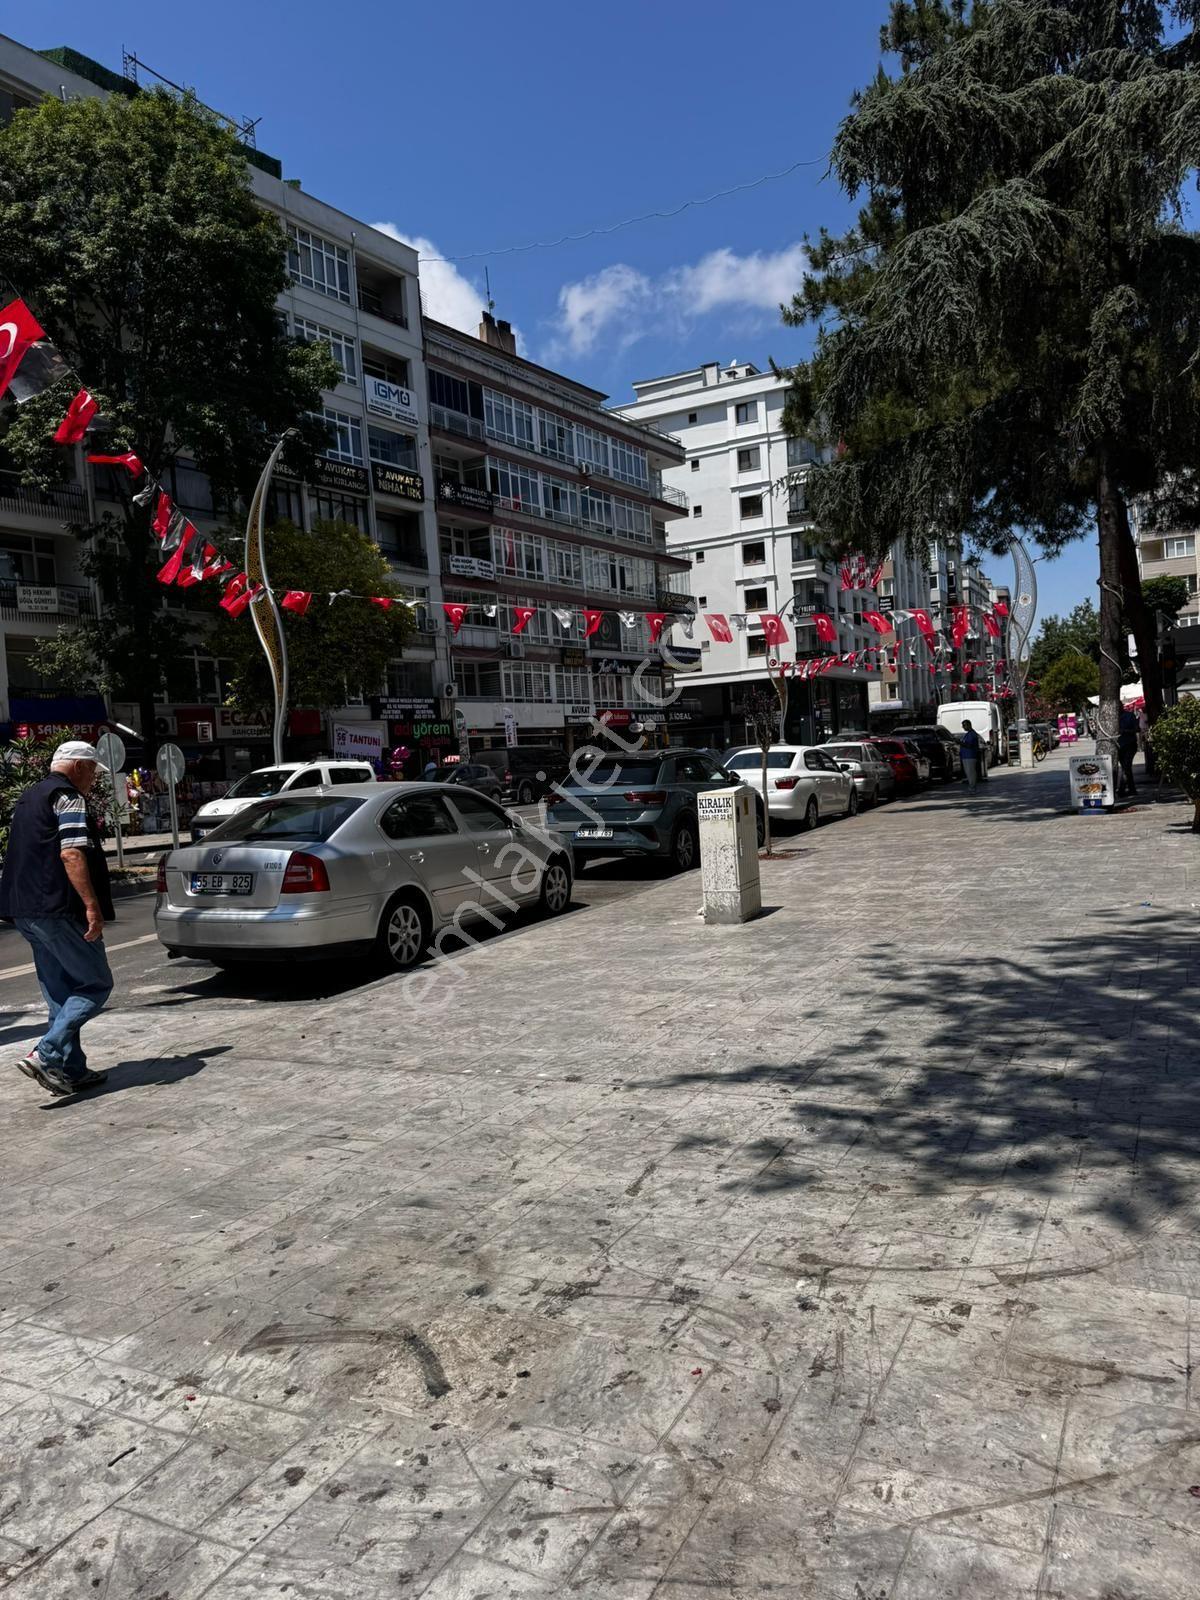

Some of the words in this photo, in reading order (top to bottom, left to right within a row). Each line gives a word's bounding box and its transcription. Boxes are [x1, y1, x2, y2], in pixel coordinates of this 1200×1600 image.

[324, 462, 356, 478] AVUKAT
[385, 471, 414, 486] AVUKAT
[378, 479, 405, 495] NİHAL
[571, 705, 590, 715] AVUKAT
[201, 726, 208, 738] E
[349, 733, 381, 747] TANTUNİ
[698, 796, 732, 809] KİRALIK
[197, 875, 208, 889] 55
[212, 875, 223, 888] EB
[233, 876, 250, 889] 825
